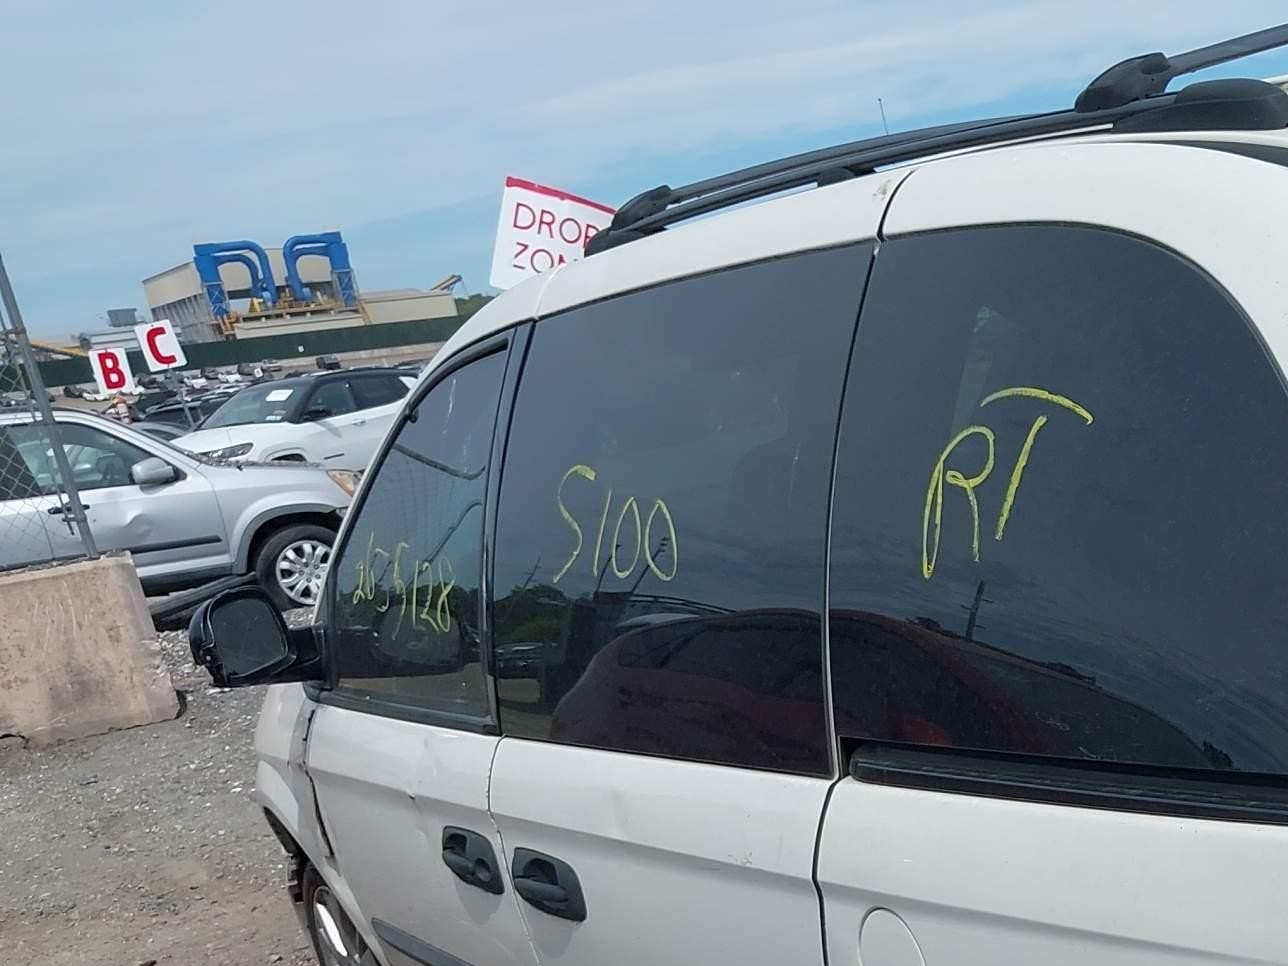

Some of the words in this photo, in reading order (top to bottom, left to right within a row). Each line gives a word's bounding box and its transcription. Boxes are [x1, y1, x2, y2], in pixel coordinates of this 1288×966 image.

[513, 202, 600, 249] DROP
[512, 242, 578, 274] ZO
[146, 326, 177, 365] C
[97, 351, 126, 390] B
[922, 386, 1094, 580] RT
